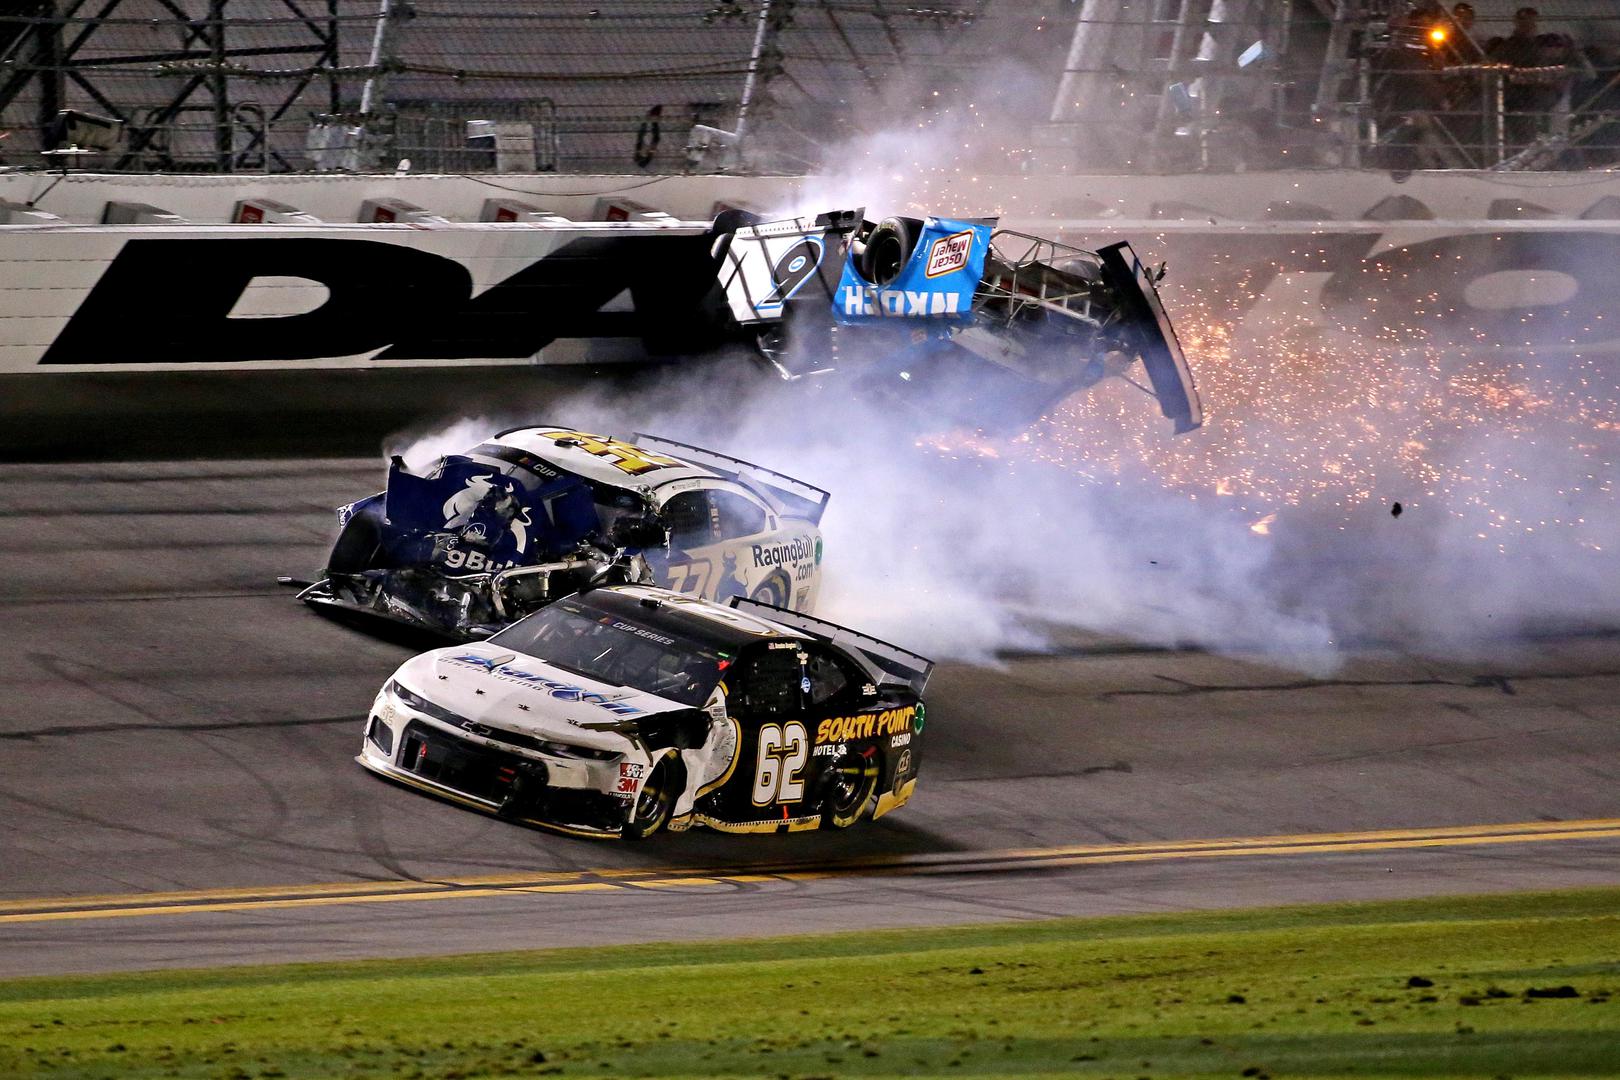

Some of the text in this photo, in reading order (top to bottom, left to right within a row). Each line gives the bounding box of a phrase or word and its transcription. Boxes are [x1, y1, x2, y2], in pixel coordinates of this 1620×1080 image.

[934, 237, 967, 257] Mayer
[933, 252, 962, 269] Oscar
[533, 463, 557, 477] CUP
[752, 534, 814, 569] RagingBull
[612, 621, 675, 646] CUP SERIES
[815, 706, 916, 744] SOUTH POINT
[812, 744, 836, 757] HOTEL
[891, 732, 911, 748] CASINO
[752, 720, 808, 807] 62
[617, 778, 638, 792] 3M
